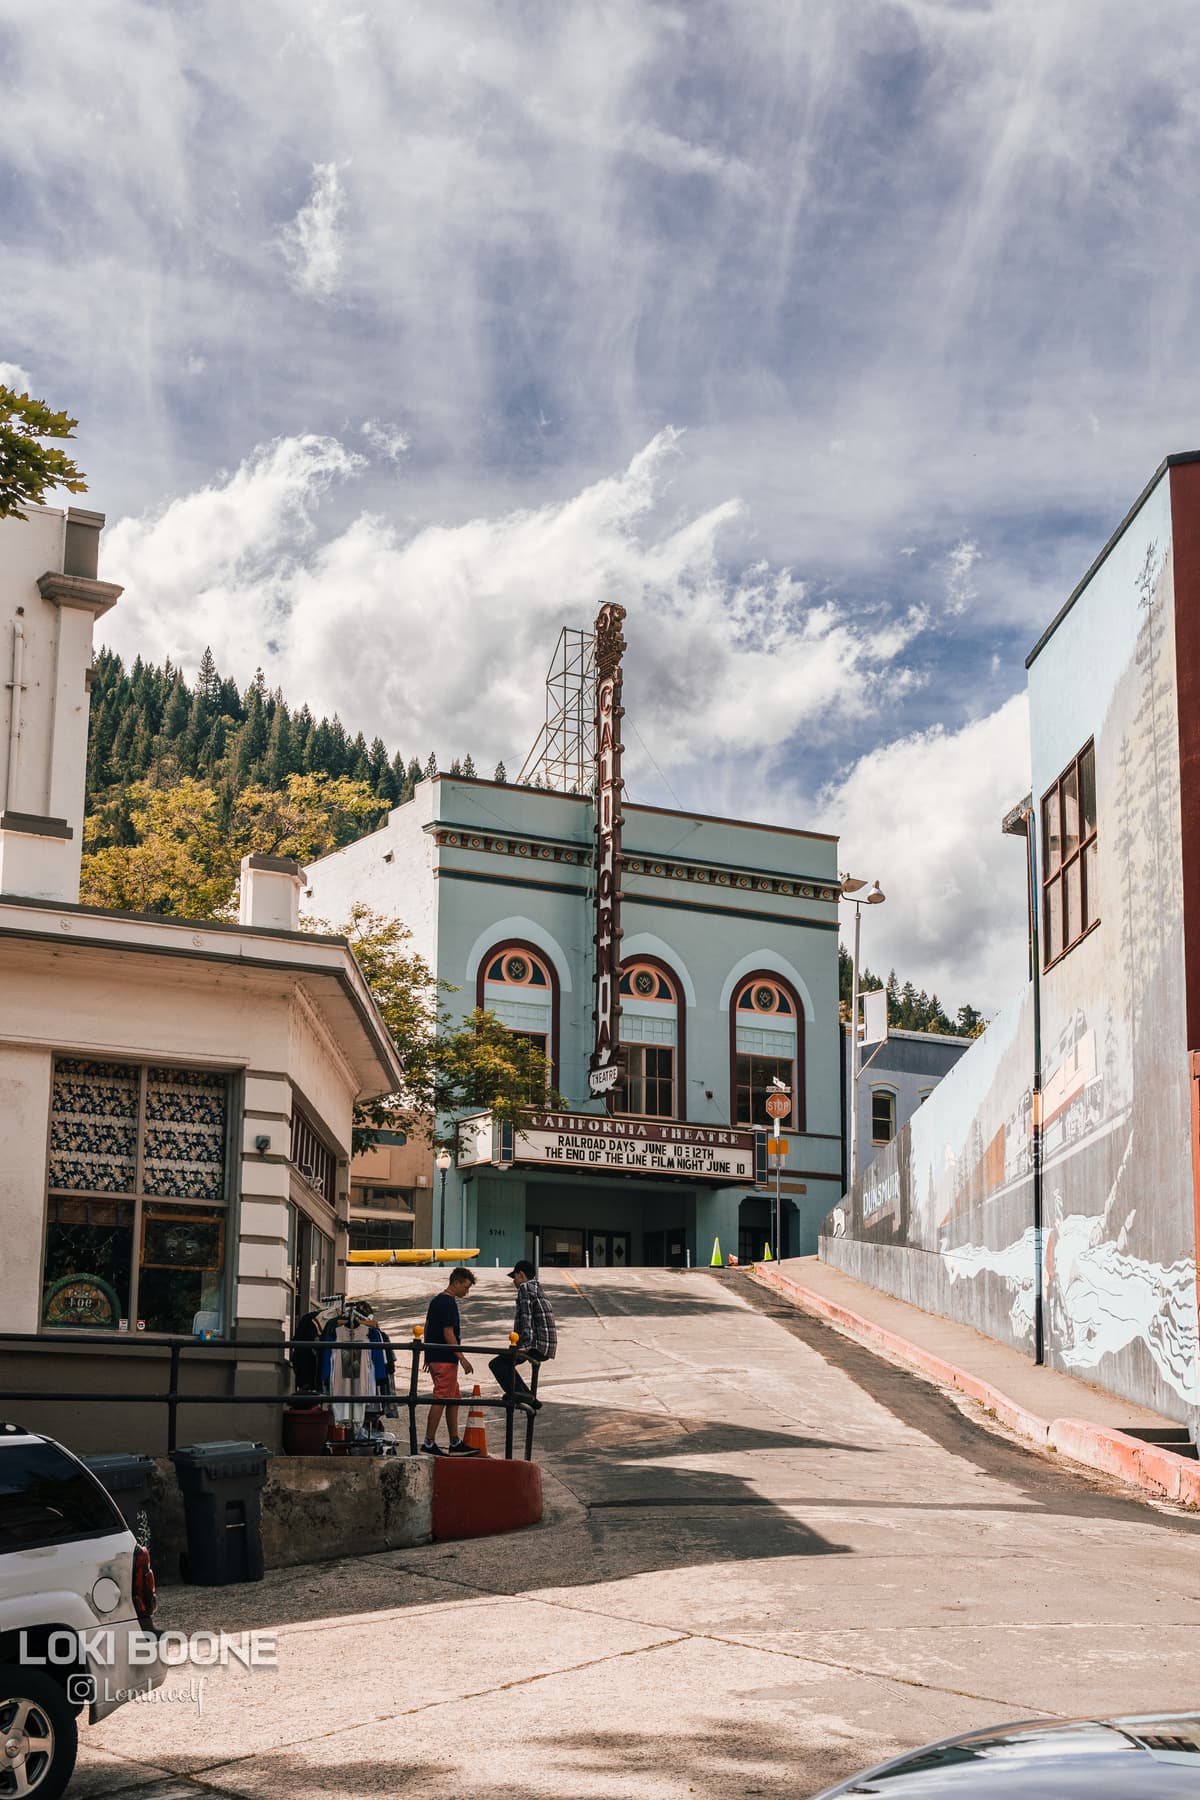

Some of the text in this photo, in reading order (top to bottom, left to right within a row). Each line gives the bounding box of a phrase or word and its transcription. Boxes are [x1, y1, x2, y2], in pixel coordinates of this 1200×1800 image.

[597, 685, 613, 1053] CALIFORNIA
[591, 1068, 617, 1085] THEATRE
[767, 1101, 790, 1112] STOP
[531, 1115, 739, 1144] CALIFORNIA THEATRE
[545, 1147, 745, 1174] THE END OF THE LINE FILM NIGHT JUNE 10
[558, 1135, 606, 1150] RAILROAD
[609, 1139, 636, 1153] DAYS
[642, 1143, 667, 1156] JUNE
[693, 1147, 714, 1160] 12TH
[863, 1171, 899, 1217] DUNSMUIR
